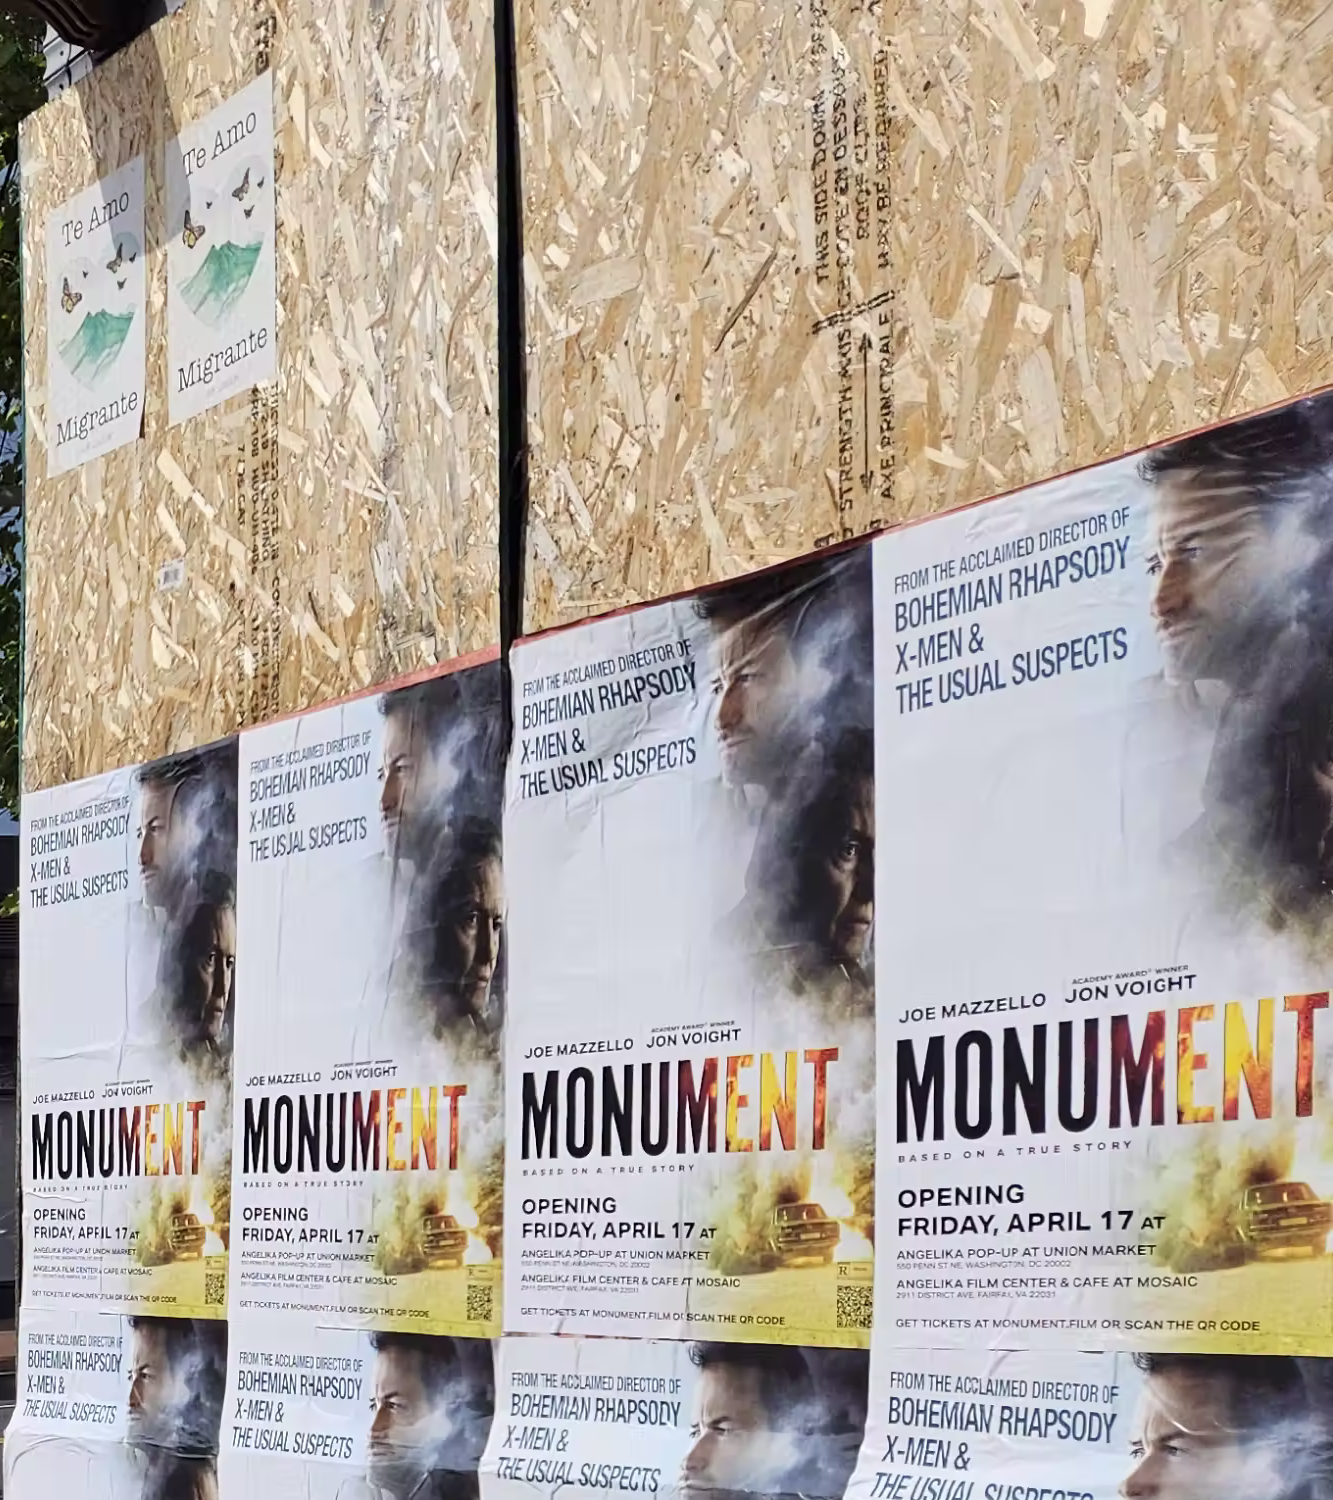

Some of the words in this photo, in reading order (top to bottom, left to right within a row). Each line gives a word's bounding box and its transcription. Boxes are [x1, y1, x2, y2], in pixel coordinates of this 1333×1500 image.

[182, 147, 207, 178] Te
[211, 111, 257, 163] Amo
[62, 216, 83, 248] Te
[88, 191, 130, 233] Amo
[178, 327, 269, 393] Migrante
[56, 390, 138, 447] Migrante
[894, 570, 929, 594] FROM
[933, 561, 955, 585] THE
[959, 540, 1034, 575] ACCLAIMED
[1039, 518, 1108, 552] DIRECTOR
[1111, 506, 1131, 529] OF
[895, 575, 1003, 632] BOHEMIAN
[1009, 536, 1131, 601] RHAPSODY
[895, 632, 962, 674] X-MEN
[968, 623, 985, 652] &
[896, 677, 933, 715] THE
[939, 661, 1006, 704] USUAL
[1012, 627, 1128, 686] SUSPECTS
[899, 1007, 936, 1024] JOE
[942, 992, 1046, 1019] MAZZELLO
[1065, 984, 1109, 1003] JON
[1115, 974, 1197, 998] VOIGHT
[1072, 974, 1113, 985] ACADEMY
[1155, 965, 1189, 974] WINNER
[896, 992, 1330, 1144] MONUMENT
[521, 1047, 839, 1160] MONUMENT
[32, 1100, 205, 1180] MONUMENT
[243, 1084, 467, 1174] MONUMENT
[898, 1151, 952, 1163] BASED
[964, 1149, 985, 1159] ON
[997, 1148, 1005, 1157] A
[1016, 1145, 1061, 1155] TRUE
[1073, 1140, 1133, 1153] STORY
[34, 1208, 86, 1221] OPENING
[243, 1207, 308, 1221] OPENING
[522, 1198, 617, 1215] OPENING
[898, 1184, 1025, 1209] OPENING
[898, 1215, 999, 1237] FRIDAY,
[1007, 1211, 1090, 1233] APRIL
[1101, 1211, 1134, 1230] 17
[1141, 1216, 1166, 1230] AT
[896, 1247, 964, 1261] ANGELIKA
[968, 1246, 1018, 1258] POP-UP
[1022, 1245, 1040, 1257] AT
[1043, 1245, 1088, 1257] UNION
[1092, 1244, 1156, 1256] MARKET
[896, 1277, 963, 1289] ANGELIKA
[967, 1277, 999, 1289] FILM
[1002, 1277, 1056, 1288] CENTER
[1061, 1277, 1069, 1288] &
[1073, 1276, 1109, 1288] CAFE
[1113, 1276, 1133, 1288] AT
[1137, 1276, 1198, 1288] MOSAIC
[896, 1318, 918, 1329] GET
[922, 1318, 971, 1330] TICKETS
[975, 1318, 989, 1329] AT
[993, 1319, 1097, 1330] MONUMENT.FILM
[1102, 1319, 1121, 1330] OR
[1124, 1319, 1163, 1331] SCAN
[1167, 1320, 1194, 1331] THE
[1198, 1320, 1216, 1332] QR
[1220, 1320, 1260, 1332] CODE
[888, 1396, 994, 1434] BOHEMIAN
[999, 1407, 1117, 1444] RHAPSODY
